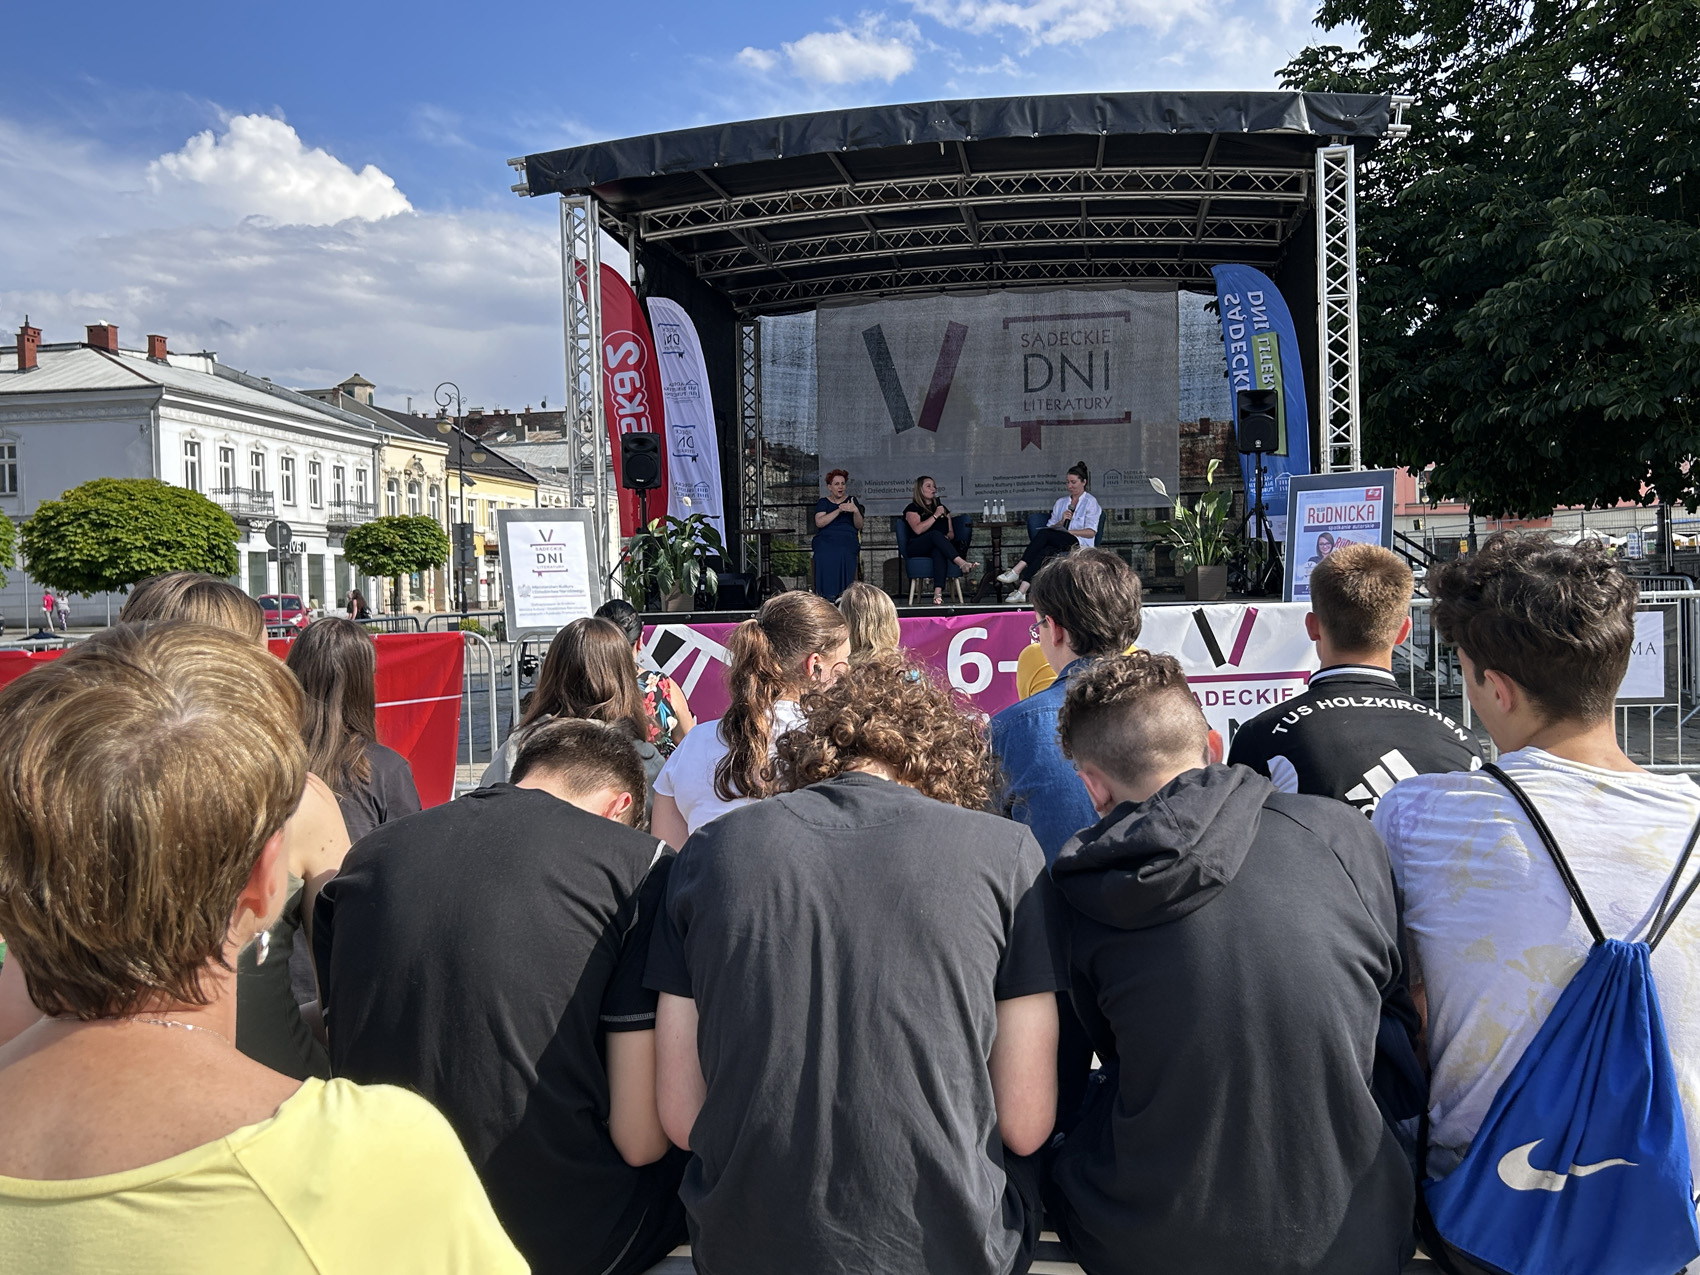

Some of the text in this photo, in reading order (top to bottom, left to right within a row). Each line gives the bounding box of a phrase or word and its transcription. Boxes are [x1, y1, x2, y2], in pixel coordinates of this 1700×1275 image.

[1021, 329, 1111, 349] SĄDECKIE
[1023, 350, 1110, 393] DNI
[1023, 396, 1113, 412] LITERATURY
[536, 553, 563, 564] DNI
[1630, 642, 1656, 655] MA
[947, 627, 1019, 694] 6-
[1272, 705, 1313, 735] TUS
[1316, 697, 1468, 742] HOLZKIRCHEN
